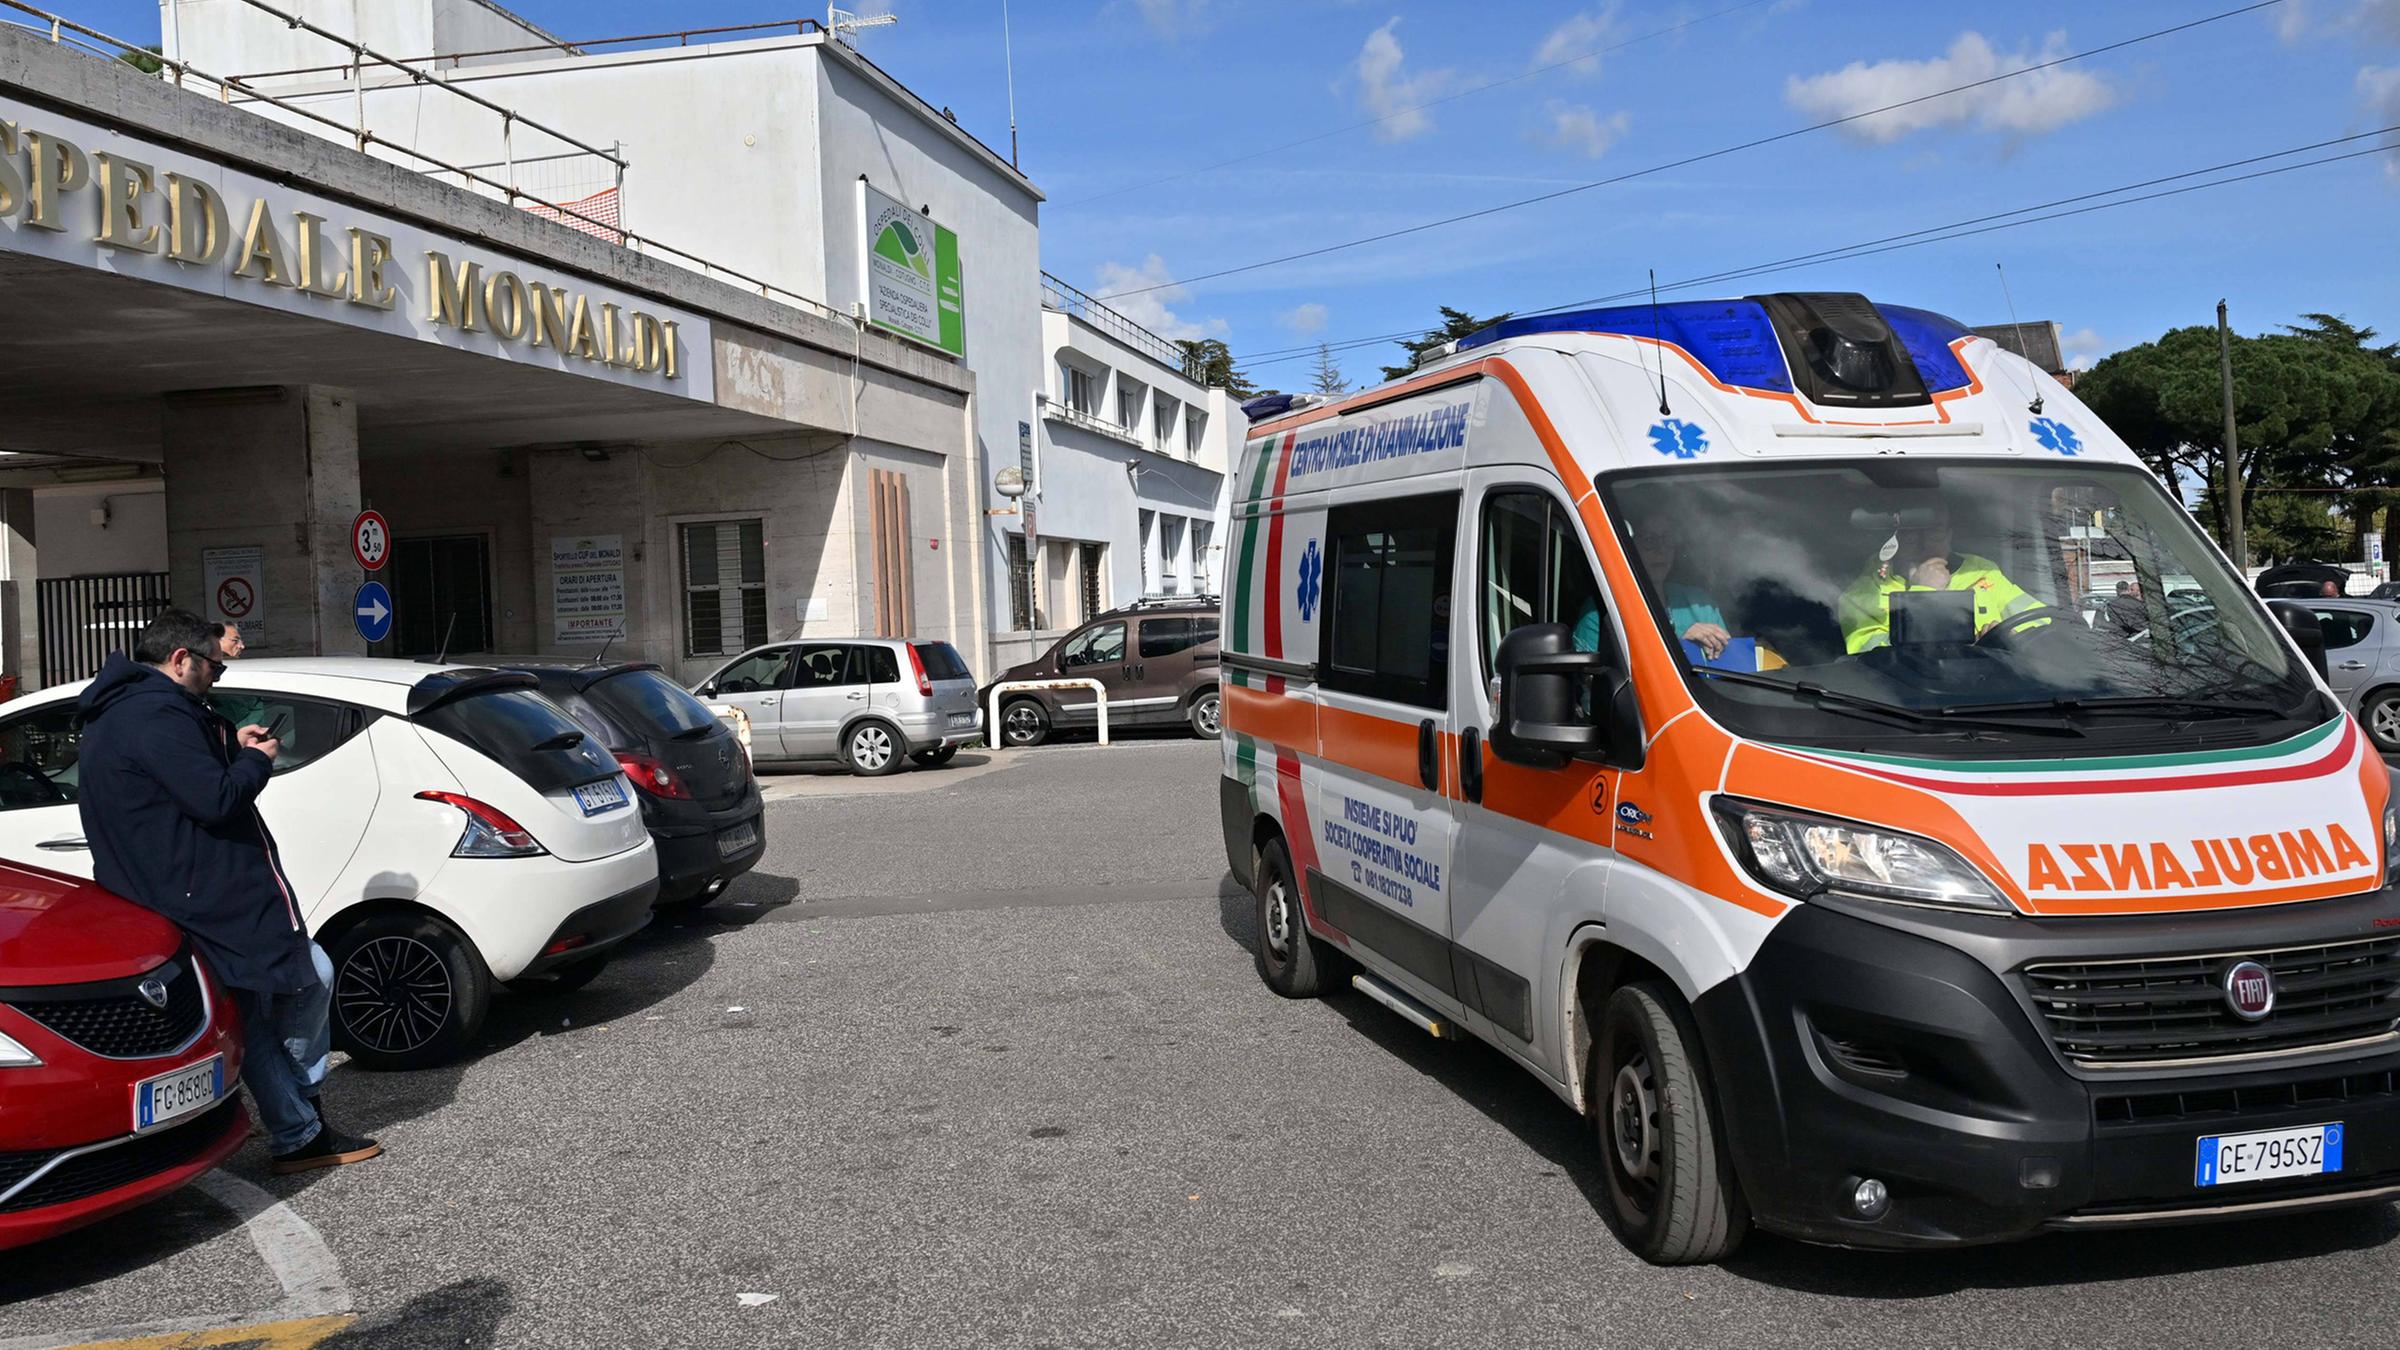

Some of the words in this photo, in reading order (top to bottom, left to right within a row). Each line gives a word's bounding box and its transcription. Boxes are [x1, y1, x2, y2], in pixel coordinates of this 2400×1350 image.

[874, 206, 901, 236] OSPEDALI
[914, 227, 930, 264] COLLI
[424, 250, 682, 379] MONALDI
[1291, 437, 1328, 477] CENTRO
[1327, 427, 1365, 470] MOBILE
[1361, 424, 1377, 463] DI
[1373, 402, 1470, 461] RIANIMAZIONE
[559, 575, 578, 585] ORARI
[579, 575, 585, 584] DI
[586, 574, 617, 584] APERTURA
[568, 619, 613, 629] IMPORTANTE
[1594, 782, 1604, 809] 2
[1344, 797, 1381, 832] INSIEME
[1383, 811, 1391, 836] SI
[1325, 819, 1353, 853] SOCIETA
[1352, 832, 1403, 876] COOPERATIVA
[1404, 852, 1440, 892] SOCIALE
[2237, 977, 2265, 1004] FIAT
